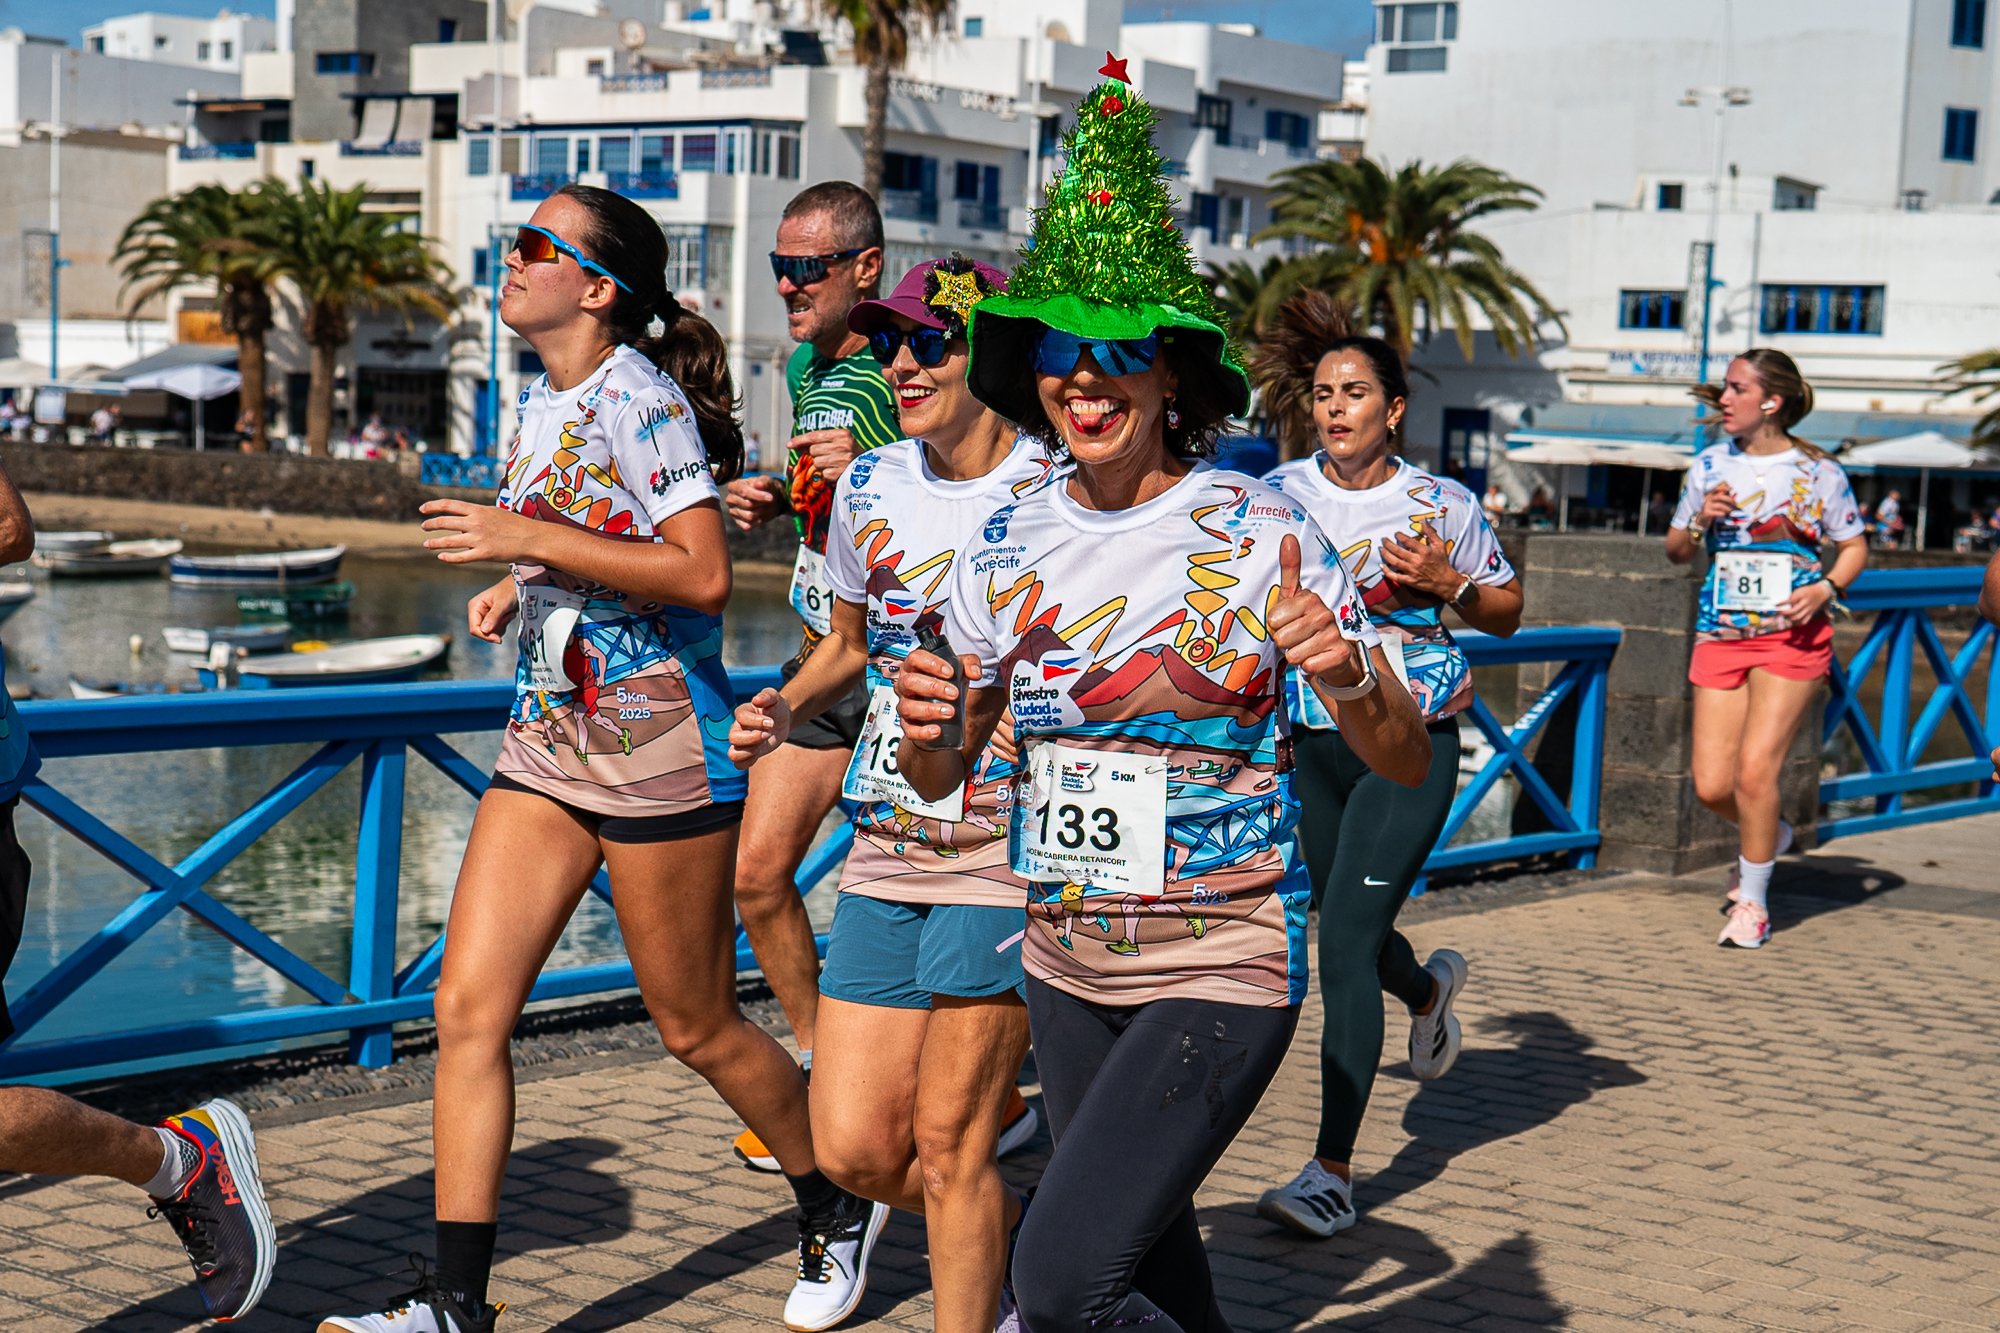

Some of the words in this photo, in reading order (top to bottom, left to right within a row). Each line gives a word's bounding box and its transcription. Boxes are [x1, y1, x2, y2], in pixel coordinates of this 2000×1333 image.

[818, 409, 854, 429] CABRA
[1249, 504, 1291, 520] Arrecife
[970, 545, 1017, 563] Ayuntamiento
[1738, 576, 1762, 594] 81
[806, 585, 834, 614] 61
[1013, 674, 1031, 688] San
[617, 686, 649, 705] 5Km
[618, 708, 651, 720] 2025
[1014, 701, 1051, 716] Ciudad
[1111, 771, 1119, 781] 5
[1120, 773, 1136, 783] KM
[896, 782, 913, 791] BETA
[1036, 800, 1121, 851] 133
[1044, 851, 1079, 862] CABRERA
[1080, 855, 1127, 867] BETANCORT
[208, 1140, 241, 1205] HOKA
